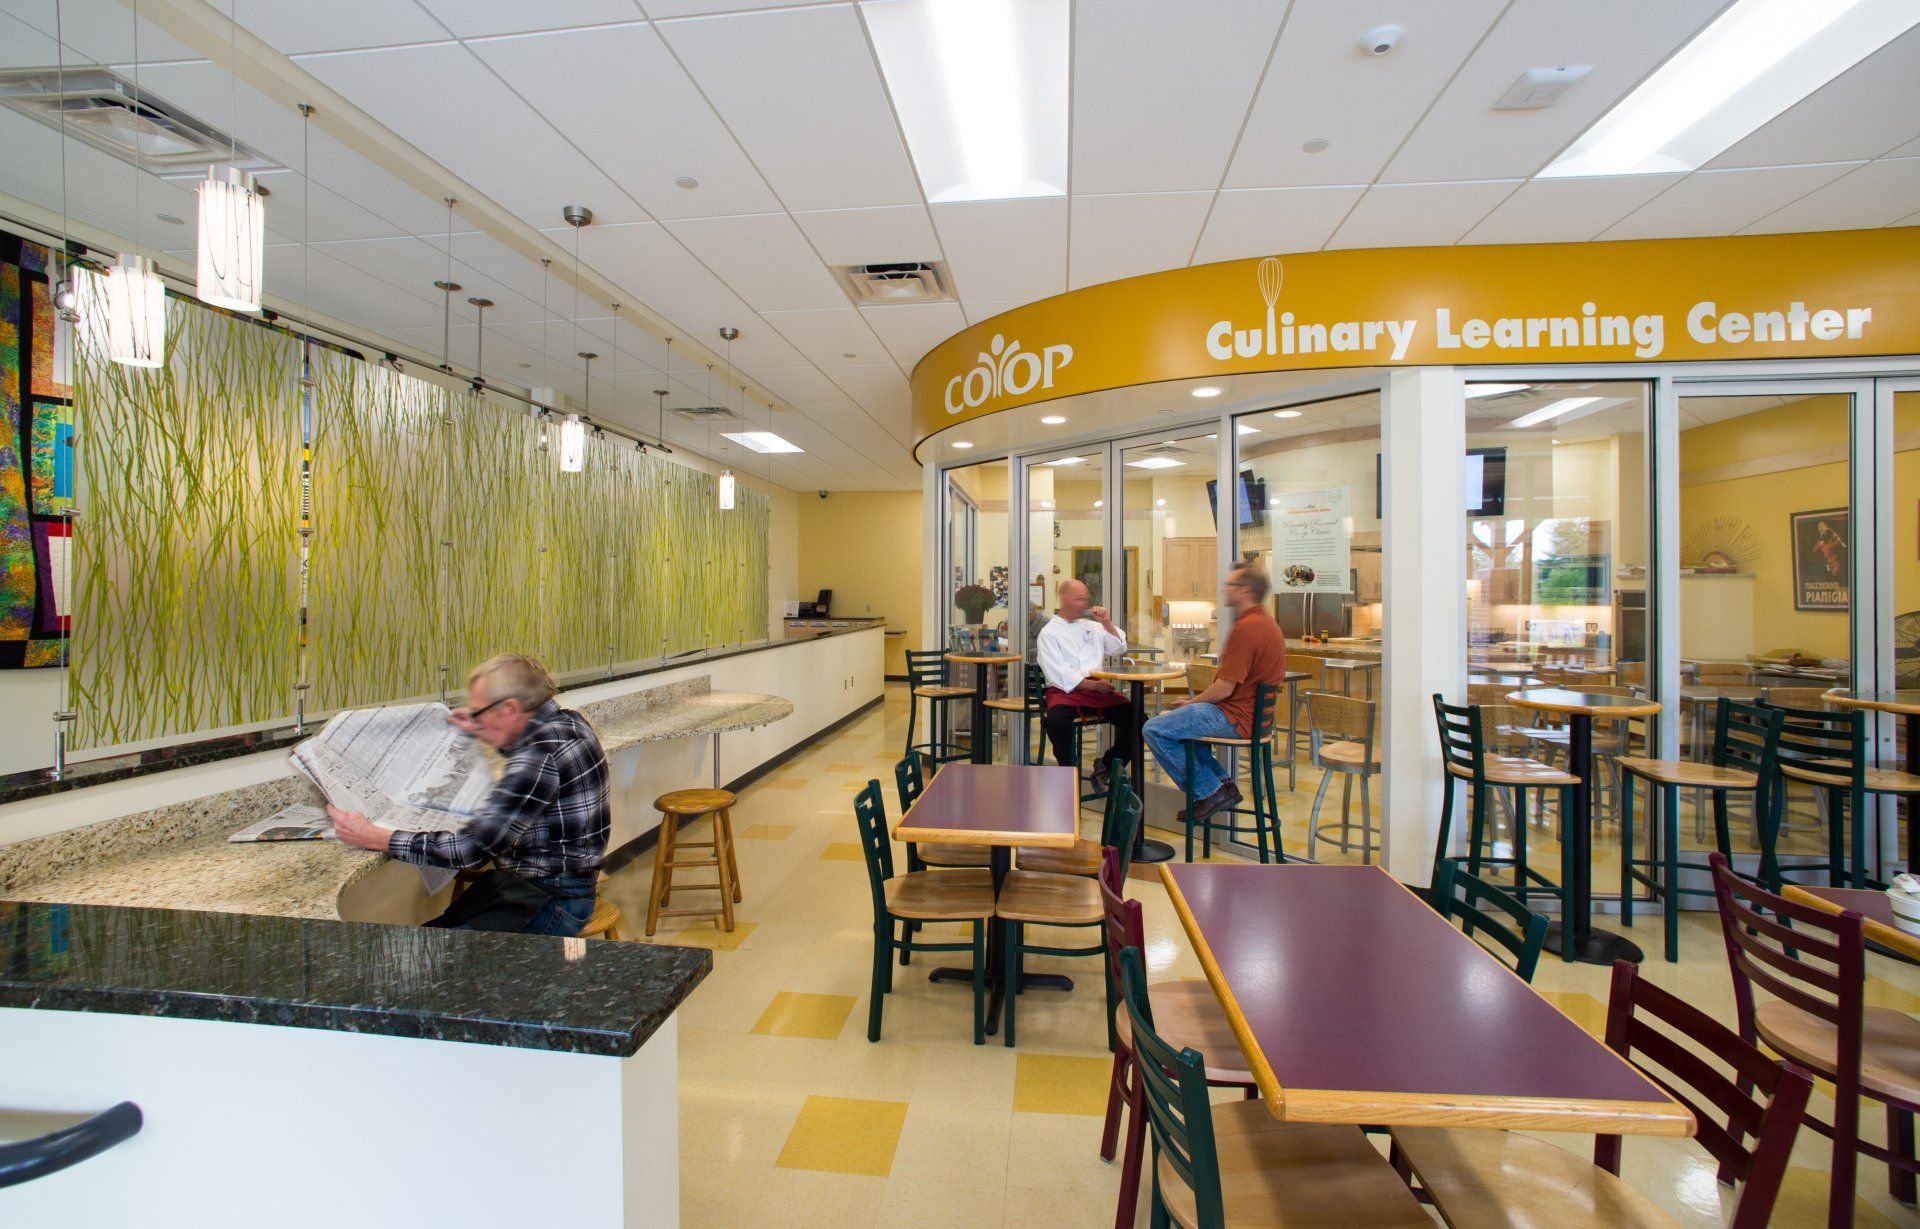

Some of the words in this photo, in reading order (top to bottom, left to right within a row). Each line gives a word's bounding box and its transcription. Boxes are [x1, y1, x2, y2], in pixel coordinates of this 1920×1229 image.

[1205, 304, 1418, 361] Culinary
[1436, 301, 1665, 359] Learning
[1686, 301, 1872, 344] Center
